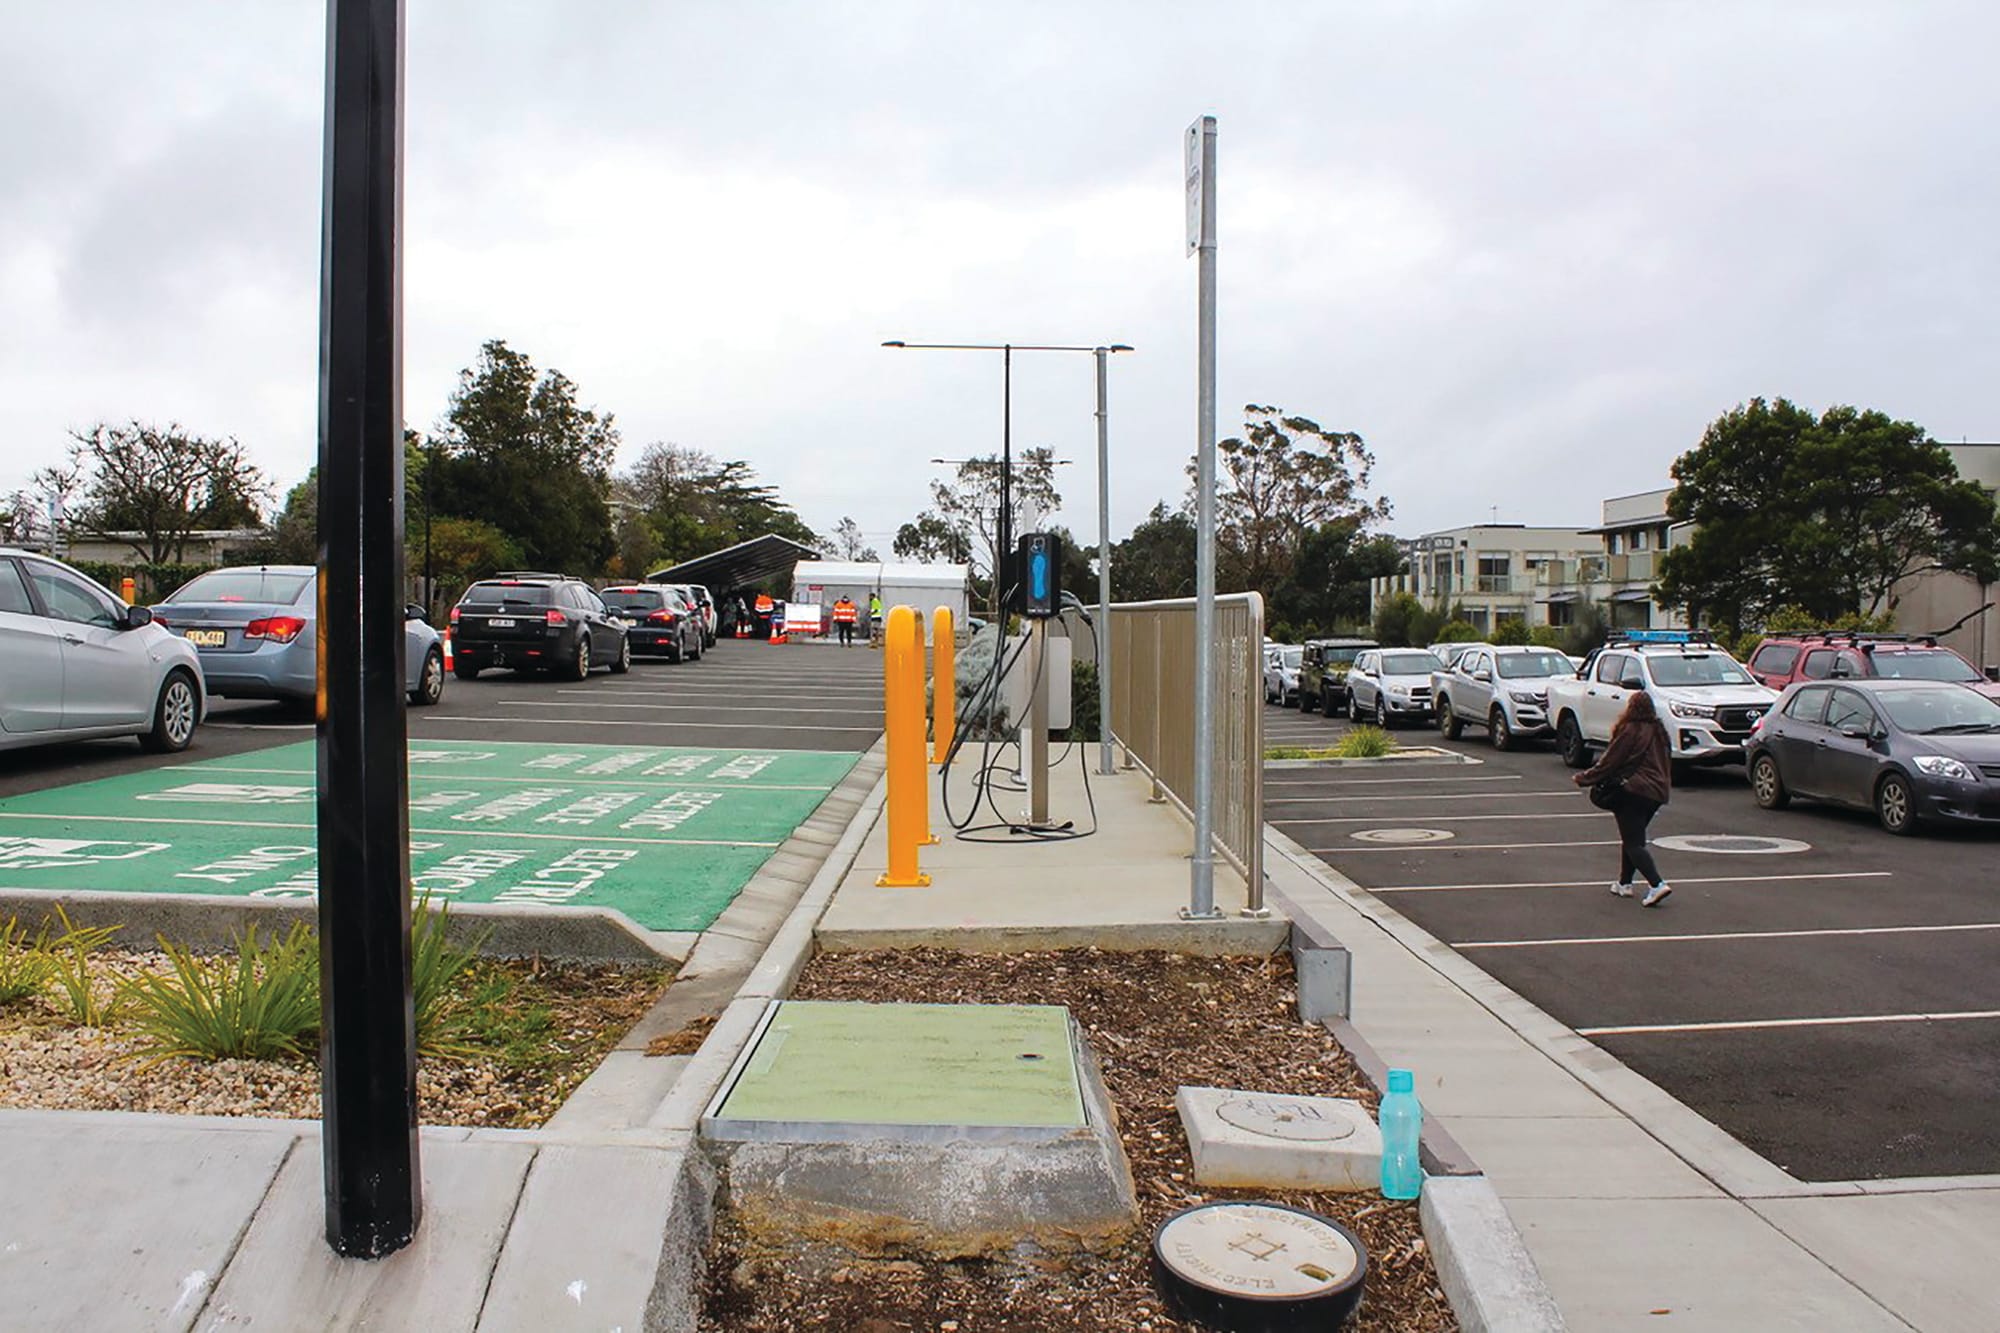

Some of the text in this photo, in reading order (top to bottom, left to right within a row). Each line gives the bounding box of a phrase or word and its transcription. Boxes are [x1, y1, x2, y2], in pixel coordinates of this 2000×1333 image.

[450, 787, 574, 822] PARKING
[535, 792, 646, 824] VEHICLE
[618, 791, 723, 831] ELECTRIC
[174, 845, 318, 884] ONLY
[490, 848, 640, 906] ELECTRI
